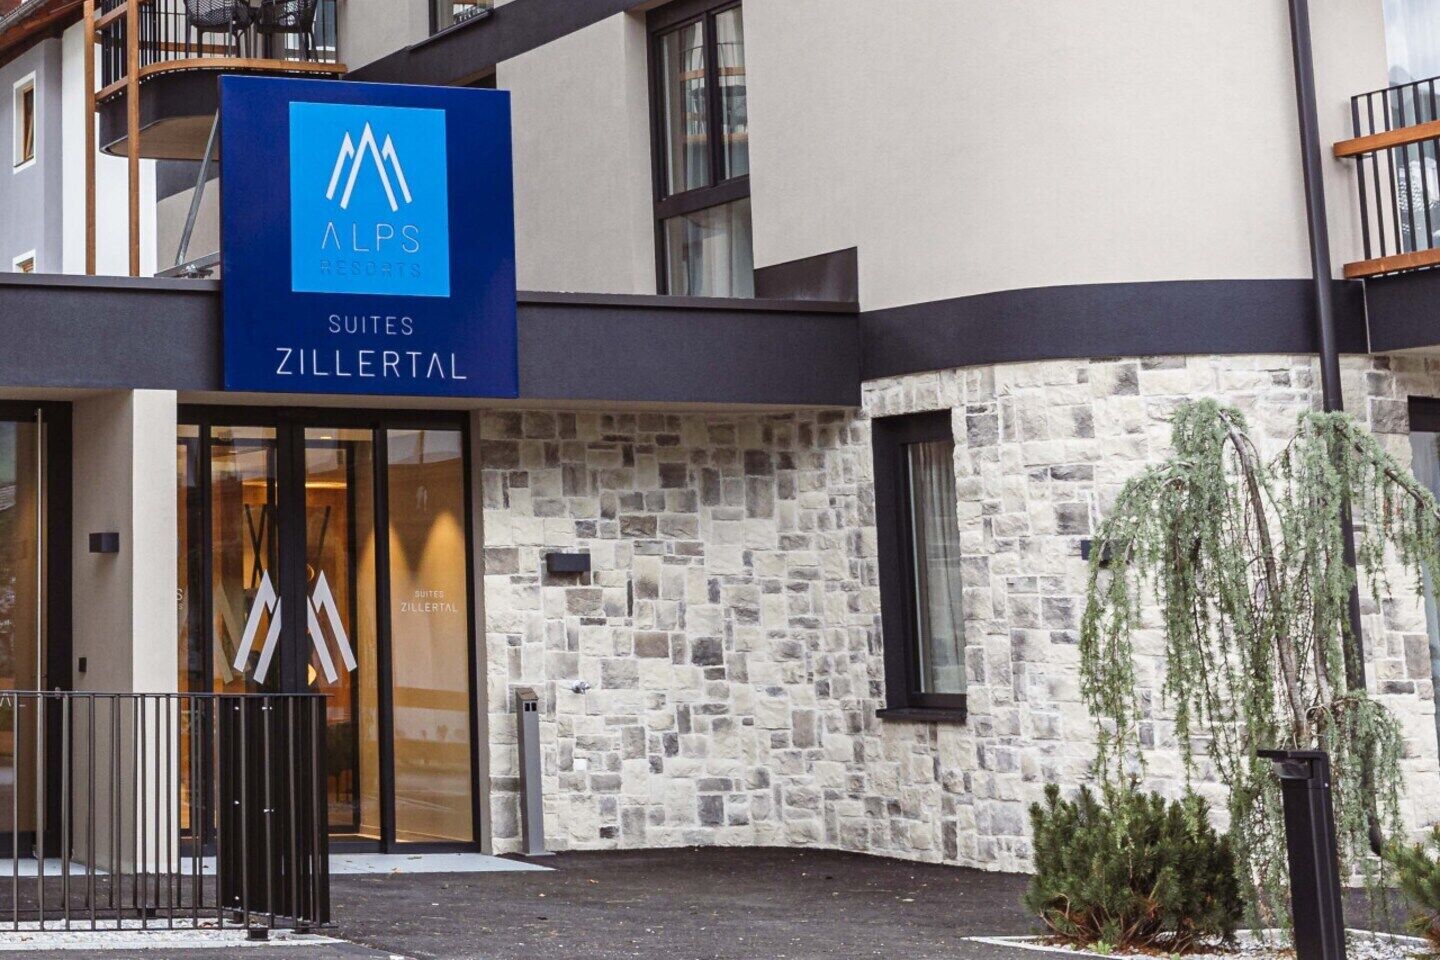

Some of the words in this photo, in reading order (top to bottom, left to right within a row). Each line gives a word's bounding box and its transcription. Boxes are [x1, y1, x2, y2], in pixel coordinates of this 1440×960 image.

[321, 221, 420, 253] ALPS
[320, 260, 421, 279] RESORTS
[328, 314, 413, 336] SUITES
[276, 347, 467, 380] ZILLERTAL
[414, 590, 445, 598] SUITES
[401, 602, 457, 613] ZILLERTAL
